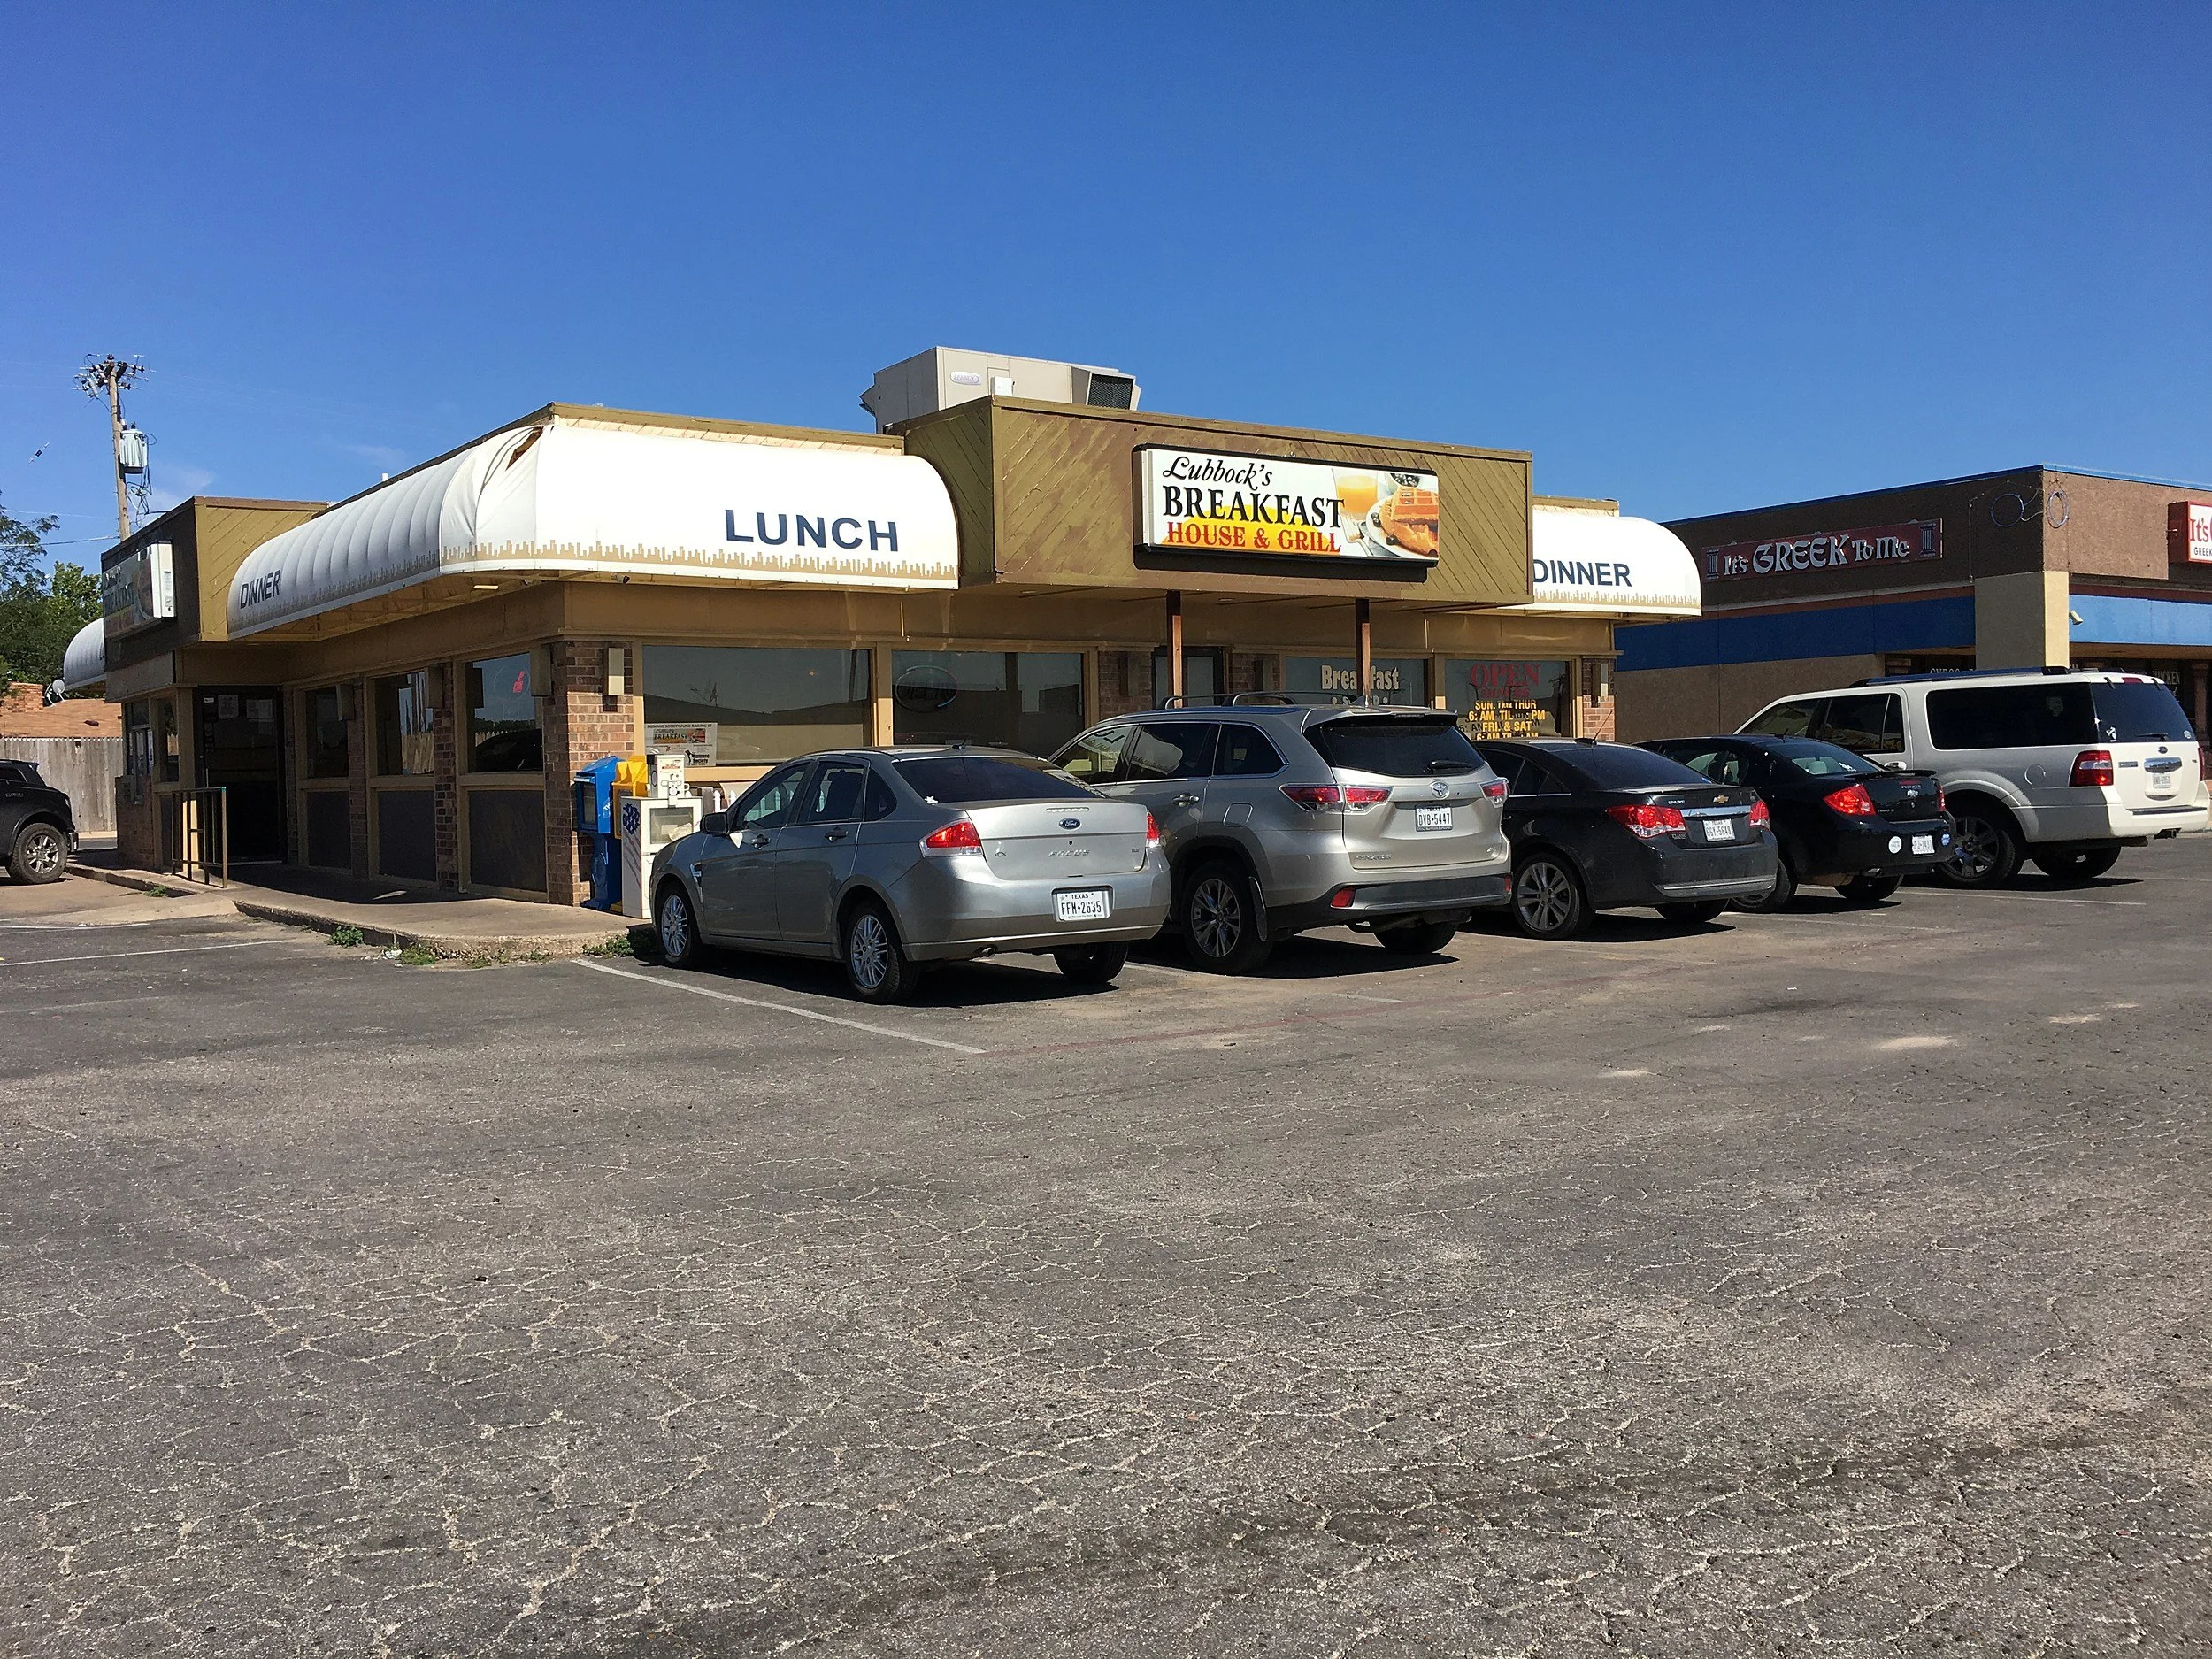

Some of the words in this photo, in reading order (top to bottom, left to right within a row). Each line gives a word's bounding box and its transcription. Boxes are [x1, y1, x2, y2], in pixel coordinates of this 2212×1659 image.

[1162, 456, 1272, 490] Lubbock's
[1163, 485, 1344, 528] BREAKFAST
[725, 509, 898, 552] LUNCH
[1167, 521, 1245, 547] HOUSE
[1253, 528, 1270, 549] &
[1277, 530, 1341, 553] GRILL
[2190, 518, 2208, 542] It's
[1724, 554, 1748, 575] It's
[1752, 534, 1849, 574] GREEK
[1851, 539, 1874, 562] To
[1876, 536, 1909, 560] Me
[1533, 559, 1632, 587] DINNER
[240, 569, 281, 609] DINNER
[1321, 664, 1399, 690] Breafast
[1471, 664, 1540, 687] OPEN
[1475, 700, 1495, 710] SUN.
[1514, 699, 1537, 709] THUR
[1479, 710, 1494, 720] AM
[1499, 710, 1513, 720] TIL
[1531, 710, 1546, 719] PM
[1482, 721, 1501, 732] FRI.
[1504, 721, 1510, 731] &
[1514, 721, 1532, 731] SAT
